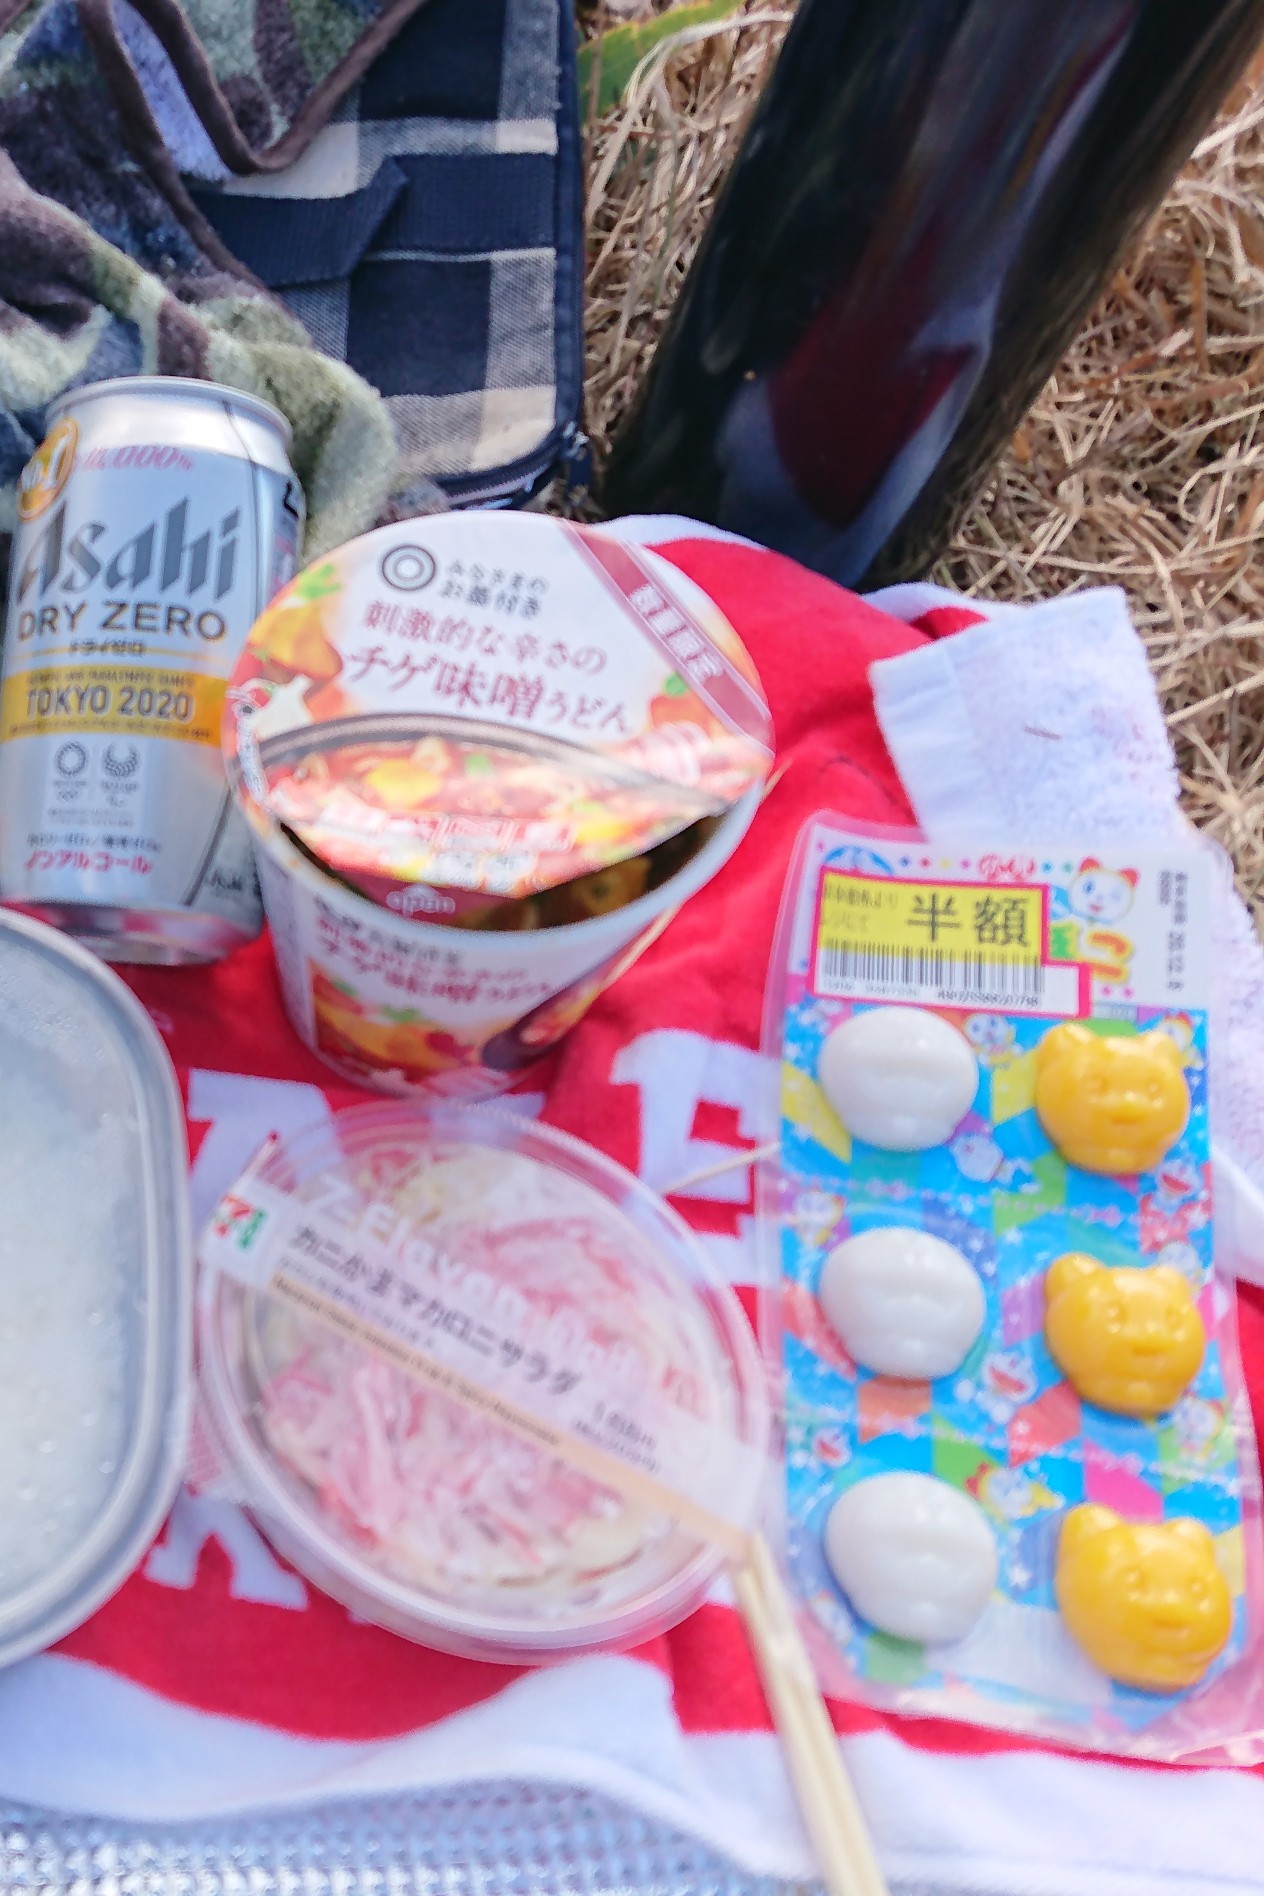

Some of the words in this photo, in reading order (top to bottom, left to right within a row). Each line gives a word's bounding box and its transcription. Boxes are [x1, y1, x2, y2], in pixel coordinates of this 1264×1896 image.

[17, 497, 240, 603] Asahi
[18, 602, 87, 642] DRY
[100, 600, 227, 642] ZERO
[364, 600, 608, 676] 刺激的な辛さの
[27, 684, 112, 720] TOKYO
[118, 685, 195, 725] 2020
[346, 645, 632, 734] チゲ味噌うどん
[24, 848, 154, 877] ノンアルコール
[906, 892, 1030, 948] 半額
[290, 1224, 583, 1396] カニかまマカロニサラダ
